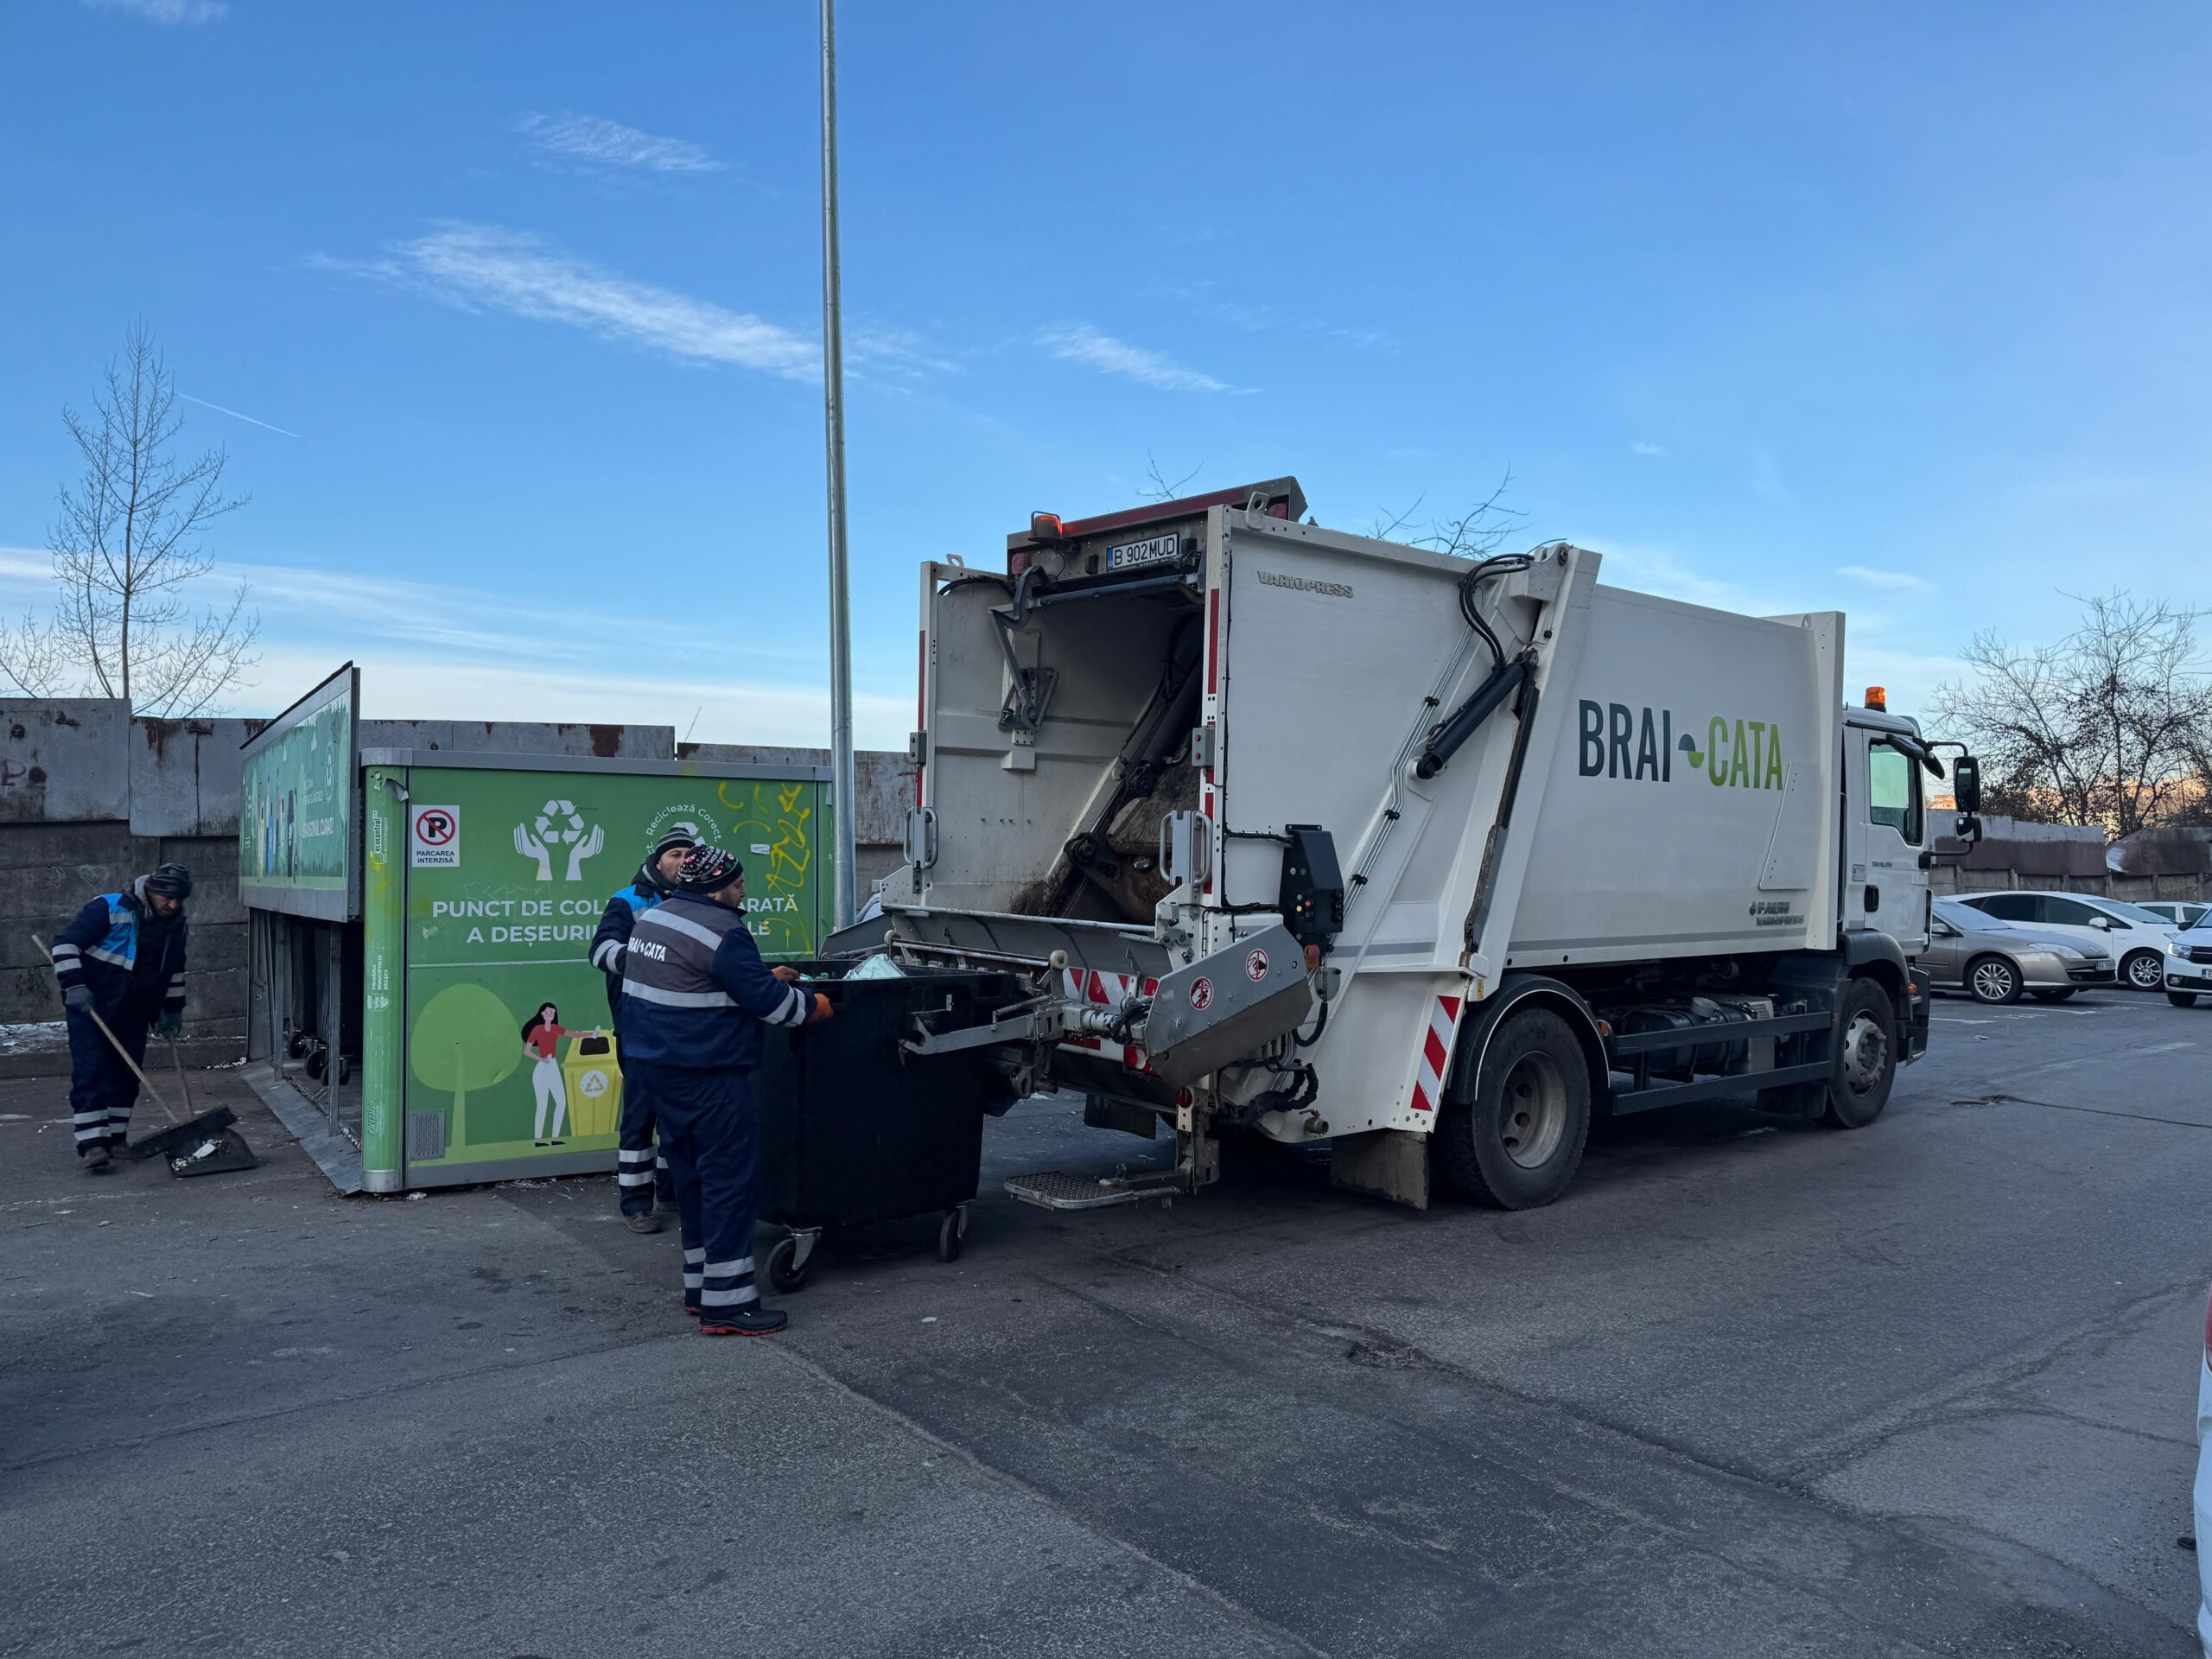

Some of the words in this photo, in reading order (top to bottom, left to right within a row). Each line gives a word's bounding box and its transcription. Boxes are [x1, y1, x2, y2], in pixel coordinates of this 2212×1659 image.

[1114, 549, 1122, 566] B
[1127, 543, 1148, 563] 902
[1149, 537, 1175, 559] MUD
[1579, 698, 1671, 783] BRAI
[1708, 715, 1783, 791] CATA
[645, 804, 696, 836] Reciclează
[432, 899, 515, 918] PUNCT
[521, 899, 553, 917] DE
[559, 899, 608, 916] COL
[737, 893, 798, 912] ARATĂ
[466, 926, 485, 944] A
[747, 920, 770, 936] LE
[644, 941, 666, 962] CATA
